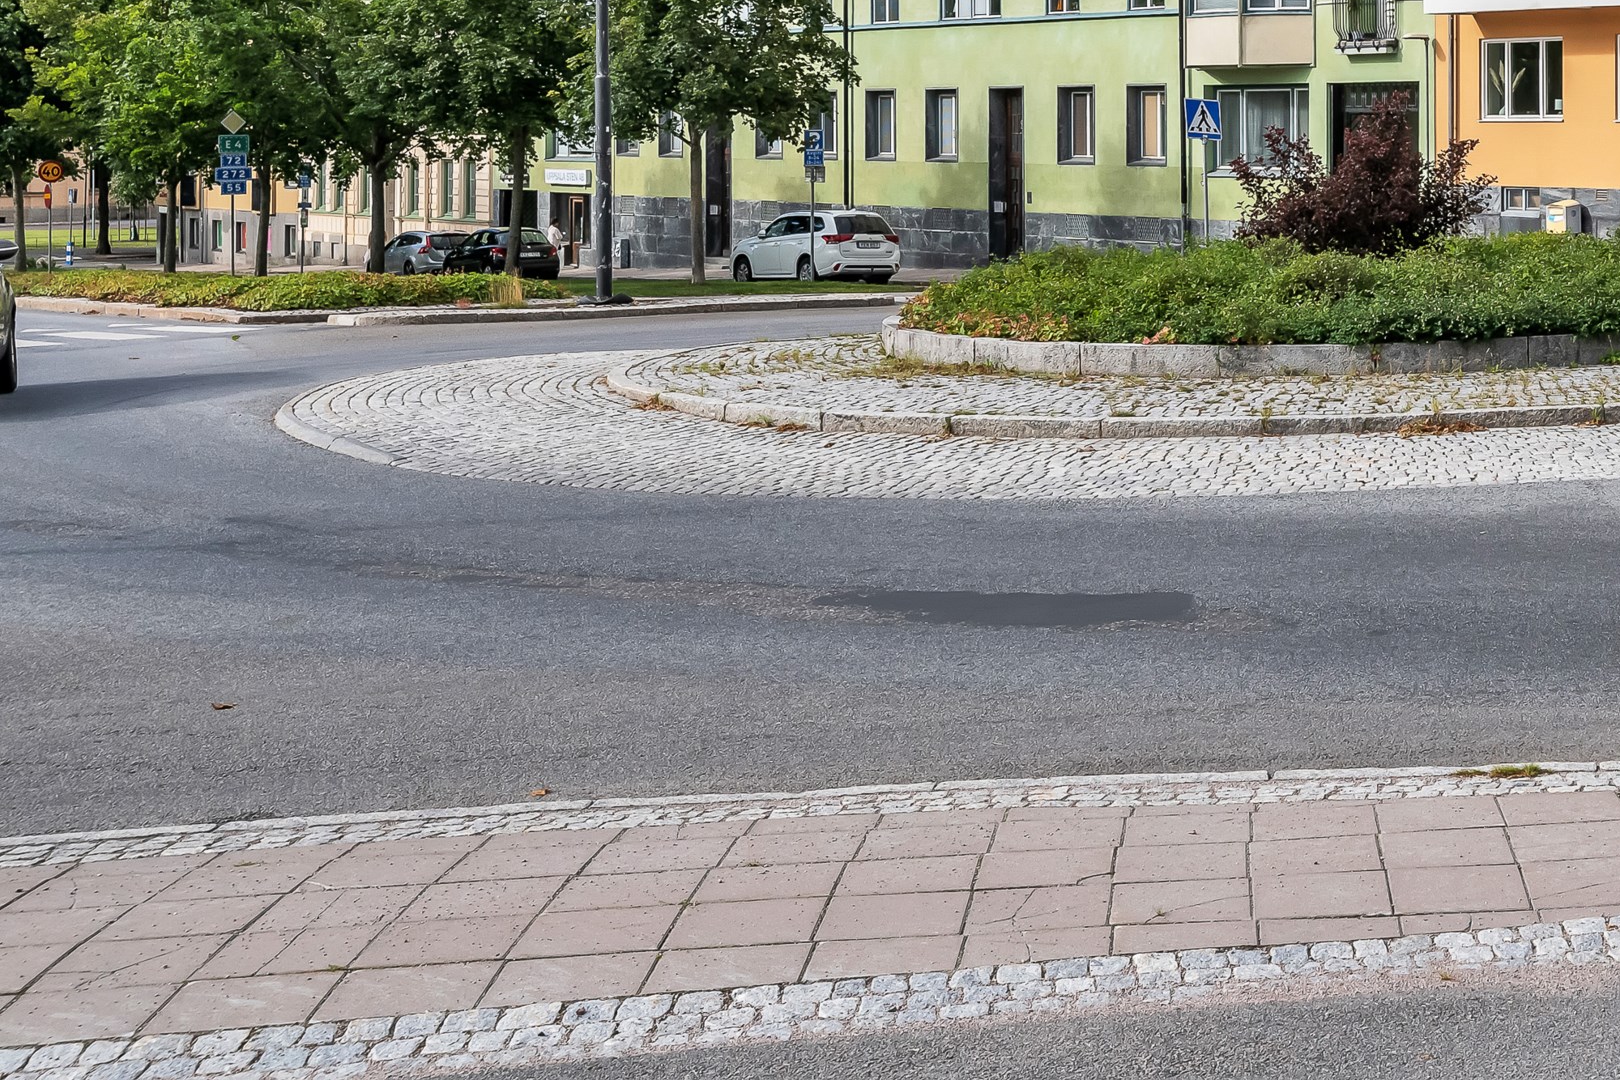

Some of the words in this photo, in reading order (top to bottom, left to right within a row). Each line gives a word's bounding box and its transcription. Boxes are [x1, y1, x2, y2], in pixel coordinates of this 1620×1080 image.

[226, 156, 241, 165] 72
[42, 166, 60, 177] 40
[222, 170, 246, 179] 272
[226, 183, 242, 192] 55
